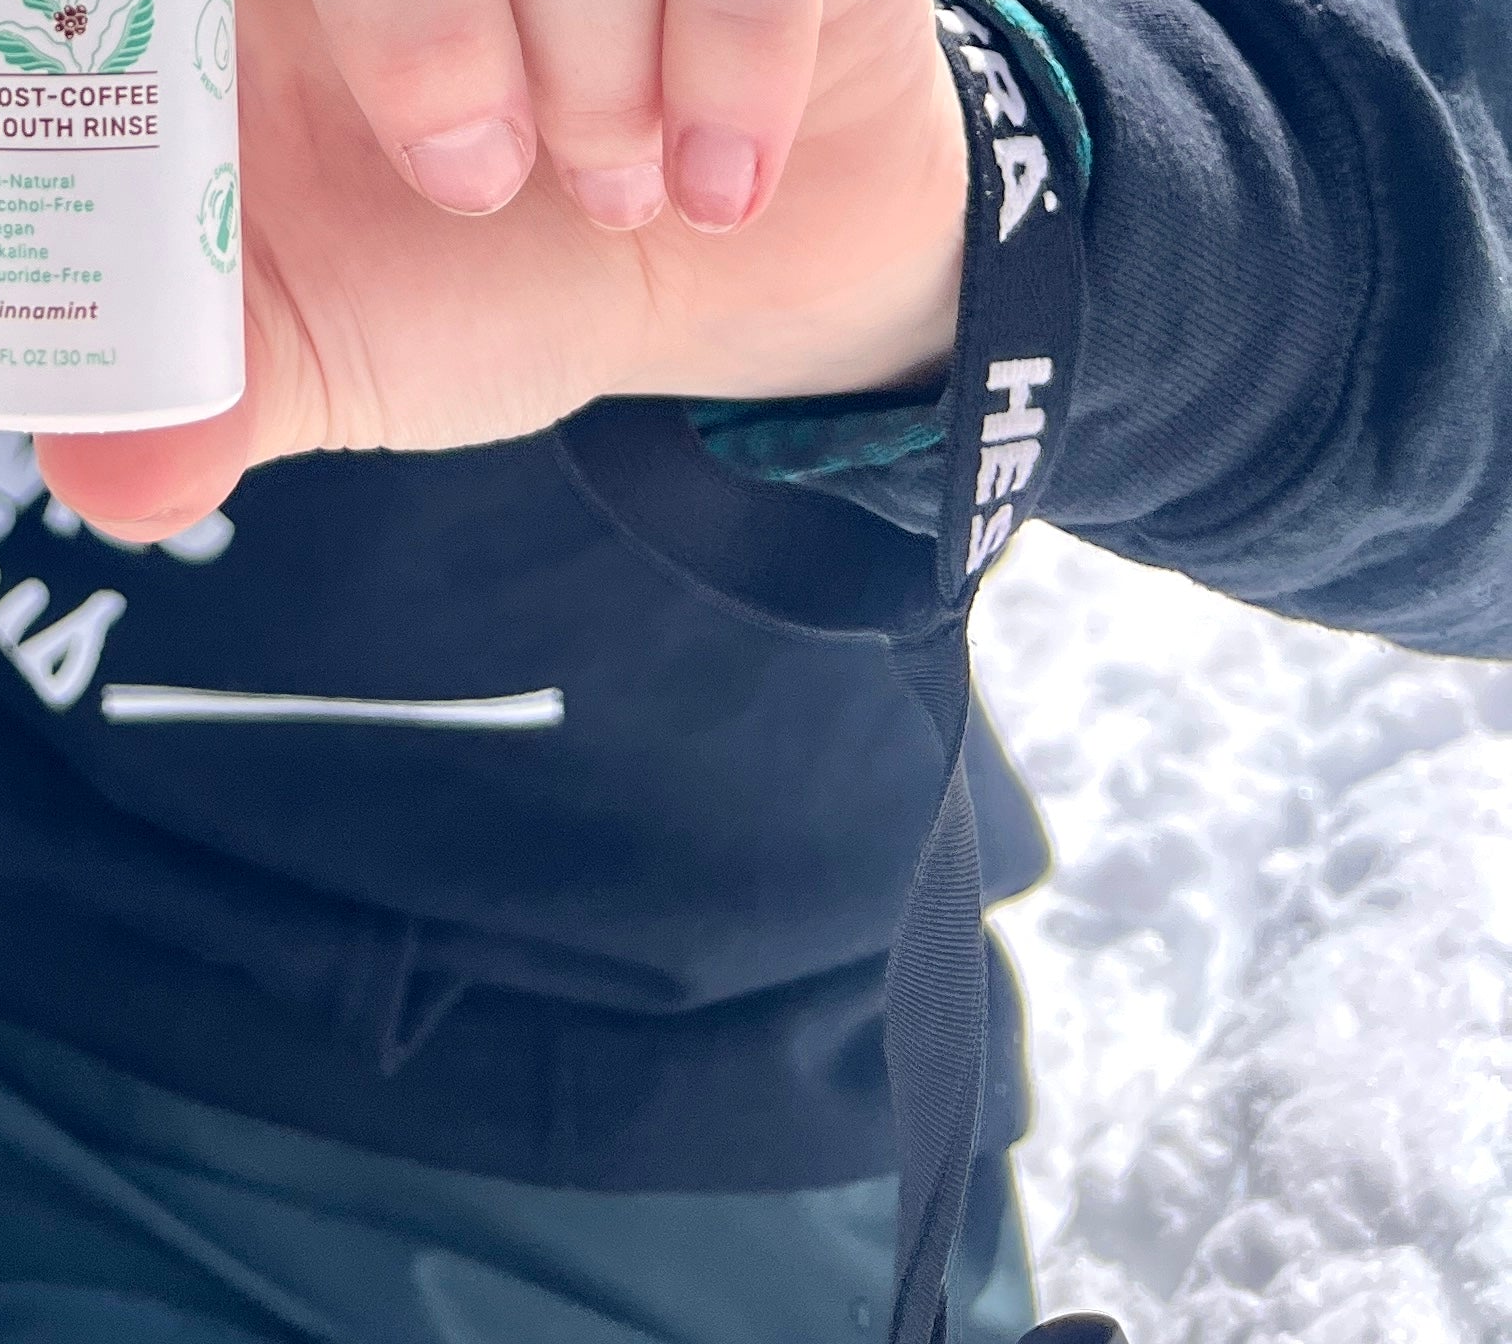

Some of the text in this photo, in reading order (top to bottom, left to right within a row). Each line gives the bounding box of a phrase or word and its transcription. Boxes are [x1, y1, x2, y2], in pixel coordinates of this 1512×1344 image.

[83, 114, 159, 138] RINSE
[0, 347, 17, 366] FL
[23, 349, 48, 366] OZ
[52, 348, 82, 366] (30
[85, 346, 117, 366] mL)
